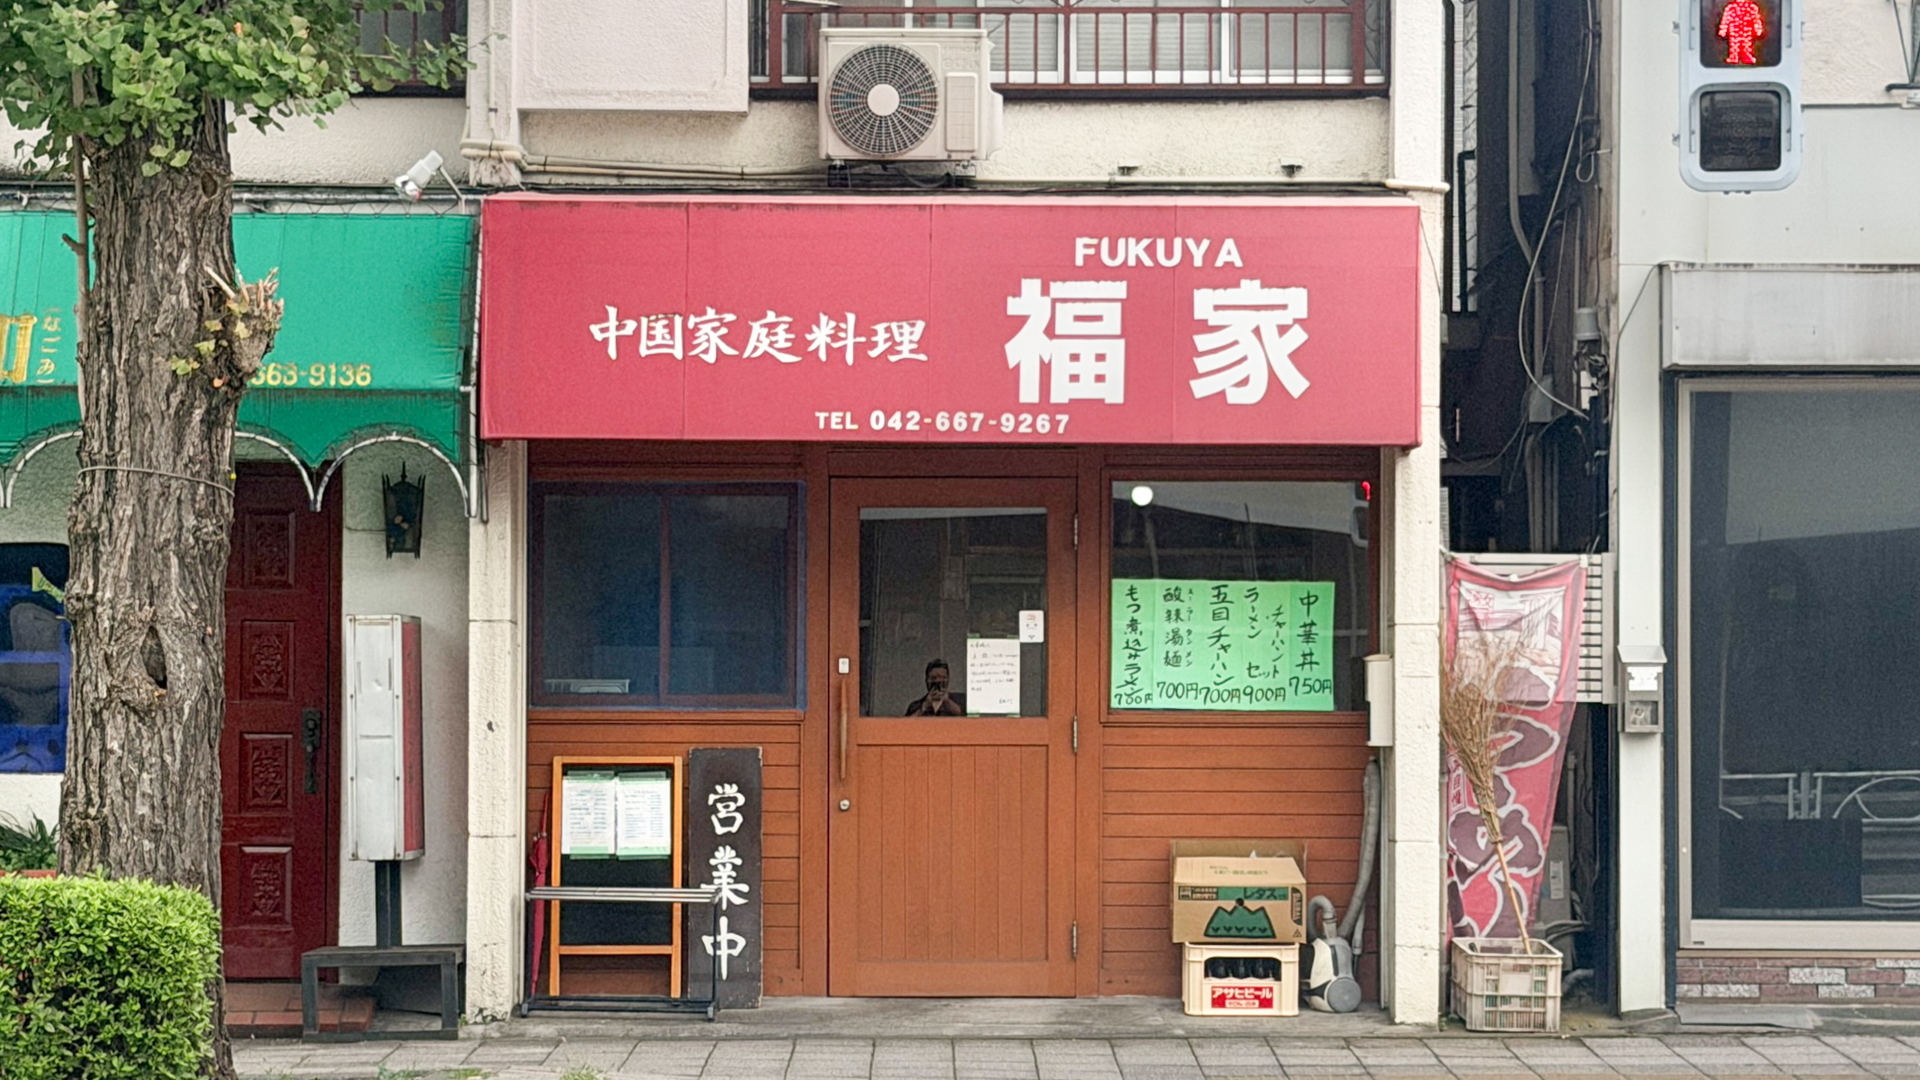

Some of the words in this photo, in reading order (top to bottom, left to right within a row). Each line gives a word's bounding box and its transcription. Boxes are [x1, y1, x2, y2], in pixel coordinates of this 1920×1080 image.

[1074, 236, 1244, 268] FUKUYA
[588, 304, 929, 367] 中国家庭料理
[1004, 277, 1311, 405] 福家
[815, 411, 859, 430] TEL
[869, 410, 1070, 434] 042-667-9267
[1244, 587, 1262, 639] ラーメン
[1207, 584, 1235, 686] 五目チャーハン
[1295, 590, 1320, 672] 中華丼
[1246, 661, 1280, 680] セット
[1157, 681, 1199, 700] 700円
[1199, 686, 1241, 706] 700円
[1242, 685, 1286, 705] 900円
[1289, 676, 1332, 697] 750円
[701, 783, 750, 981] 営業中
[1243, 886, 1278, 900] レタス
[1211, 987, 1273, 999] アサヒビール
